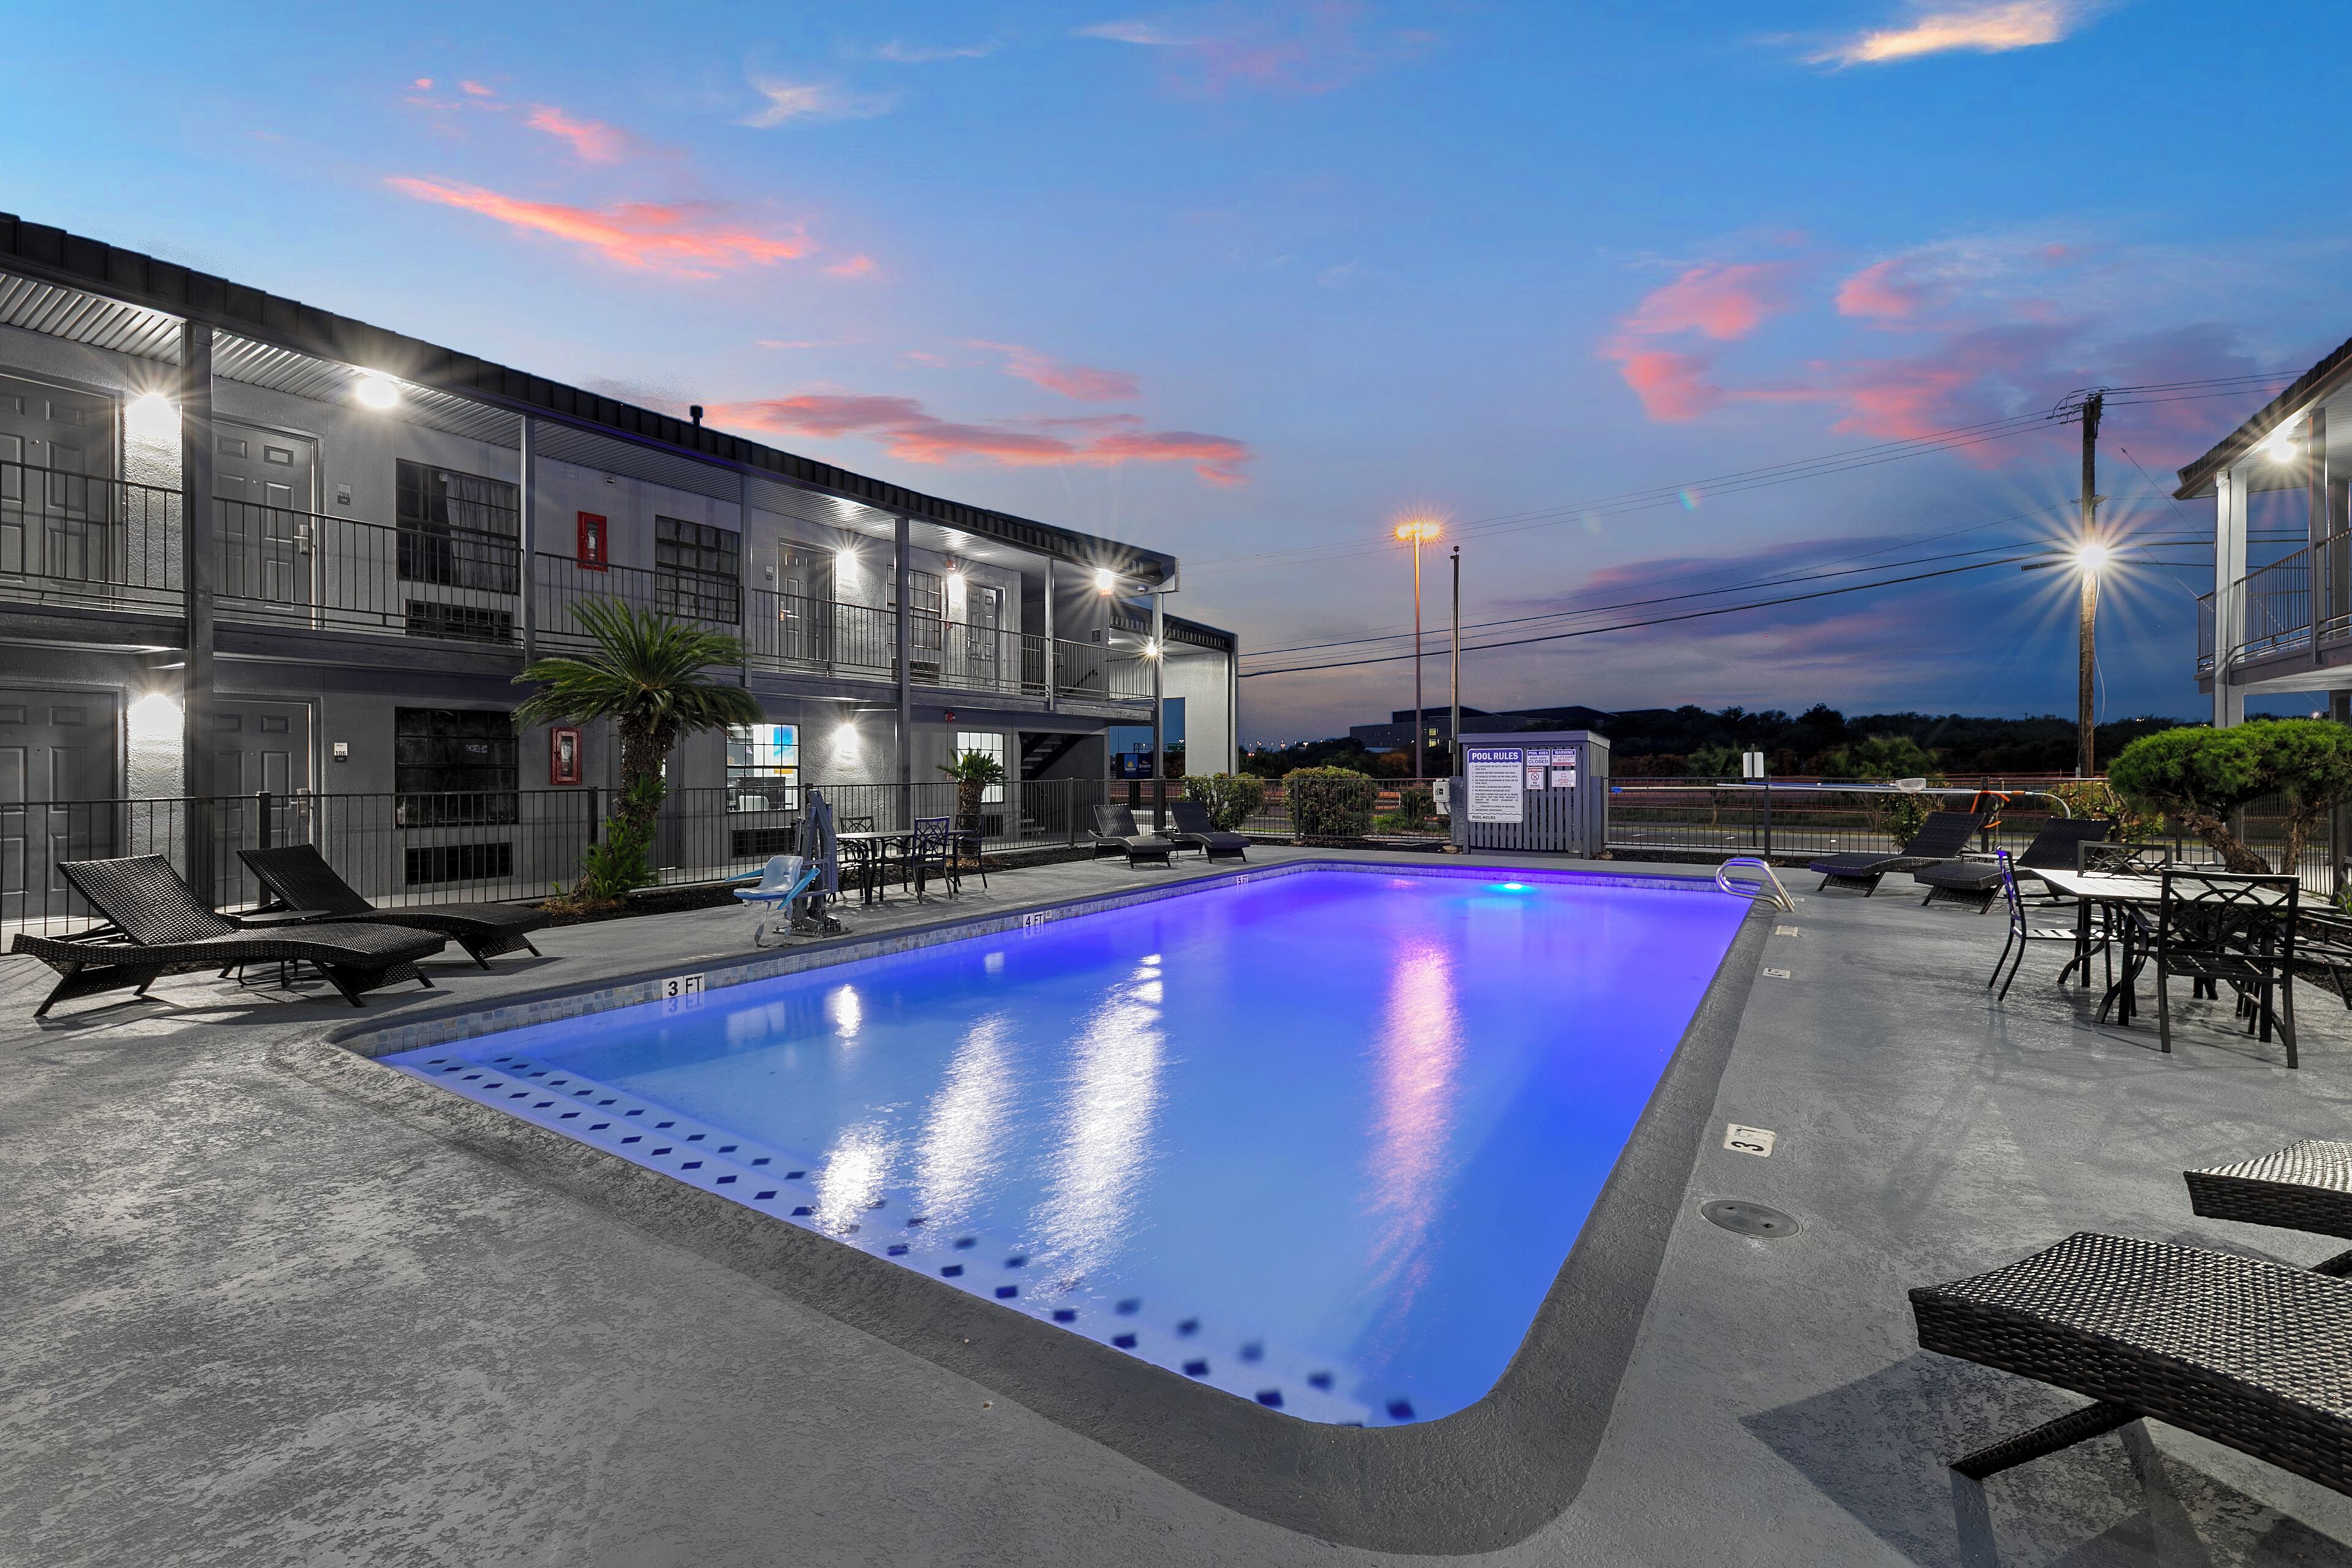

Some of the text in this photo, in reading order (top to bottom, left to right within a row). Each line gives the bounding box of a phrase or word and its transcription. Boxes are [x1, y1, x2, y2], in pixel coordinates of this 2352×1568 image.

[1493, 752, 1519, 760] RULES
[1025, 913, 1042, 927] 4 FT
[668, 976, 703, 997] 3 FT
[1730, 1140, 1765, 1152] 3
